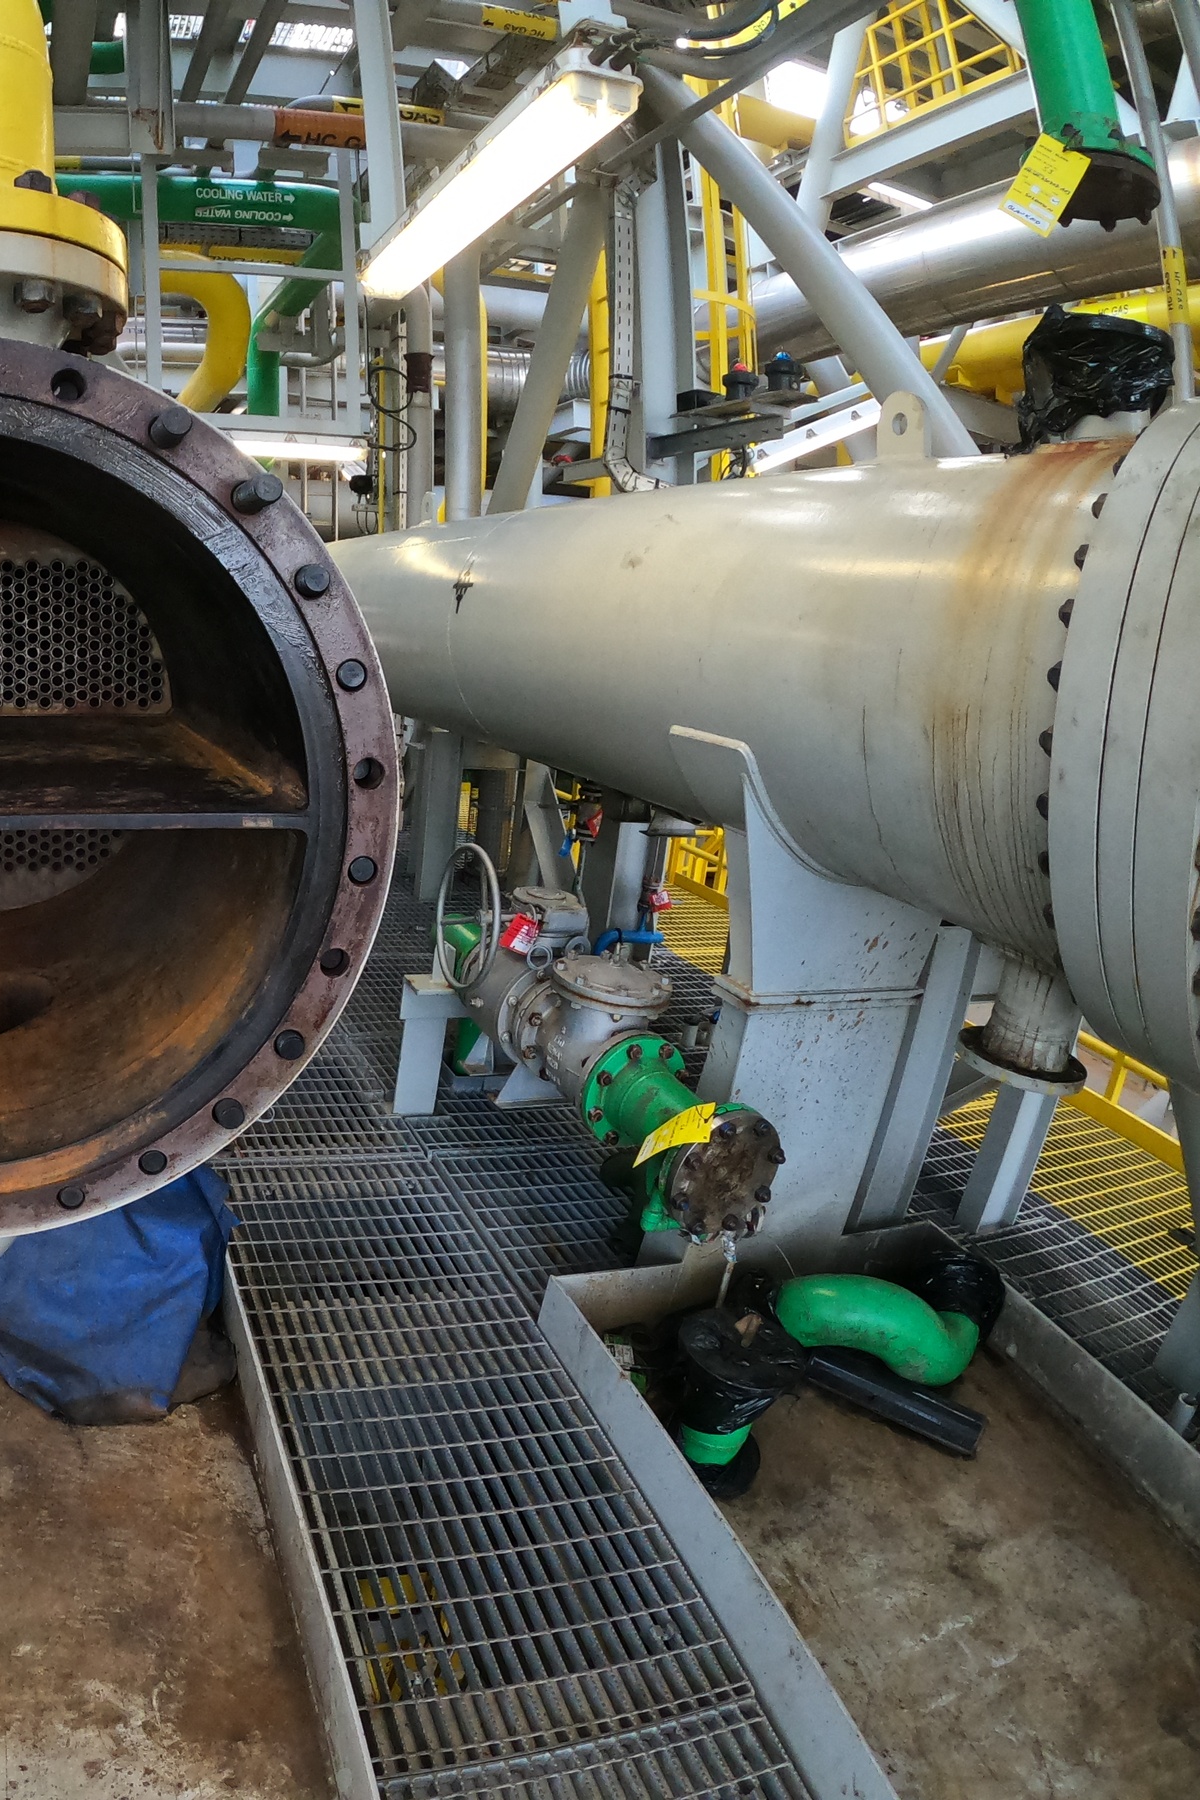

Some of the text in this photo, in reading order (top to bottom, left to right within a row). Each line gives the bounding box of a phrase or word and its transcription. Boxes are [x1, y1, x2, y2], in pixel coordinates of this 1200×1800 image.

[196, 187, 282, 203] COOLING WATER
[195, 207, 282, 221] COOLING WATER
[1111, 304, 1129, 314] GAS
